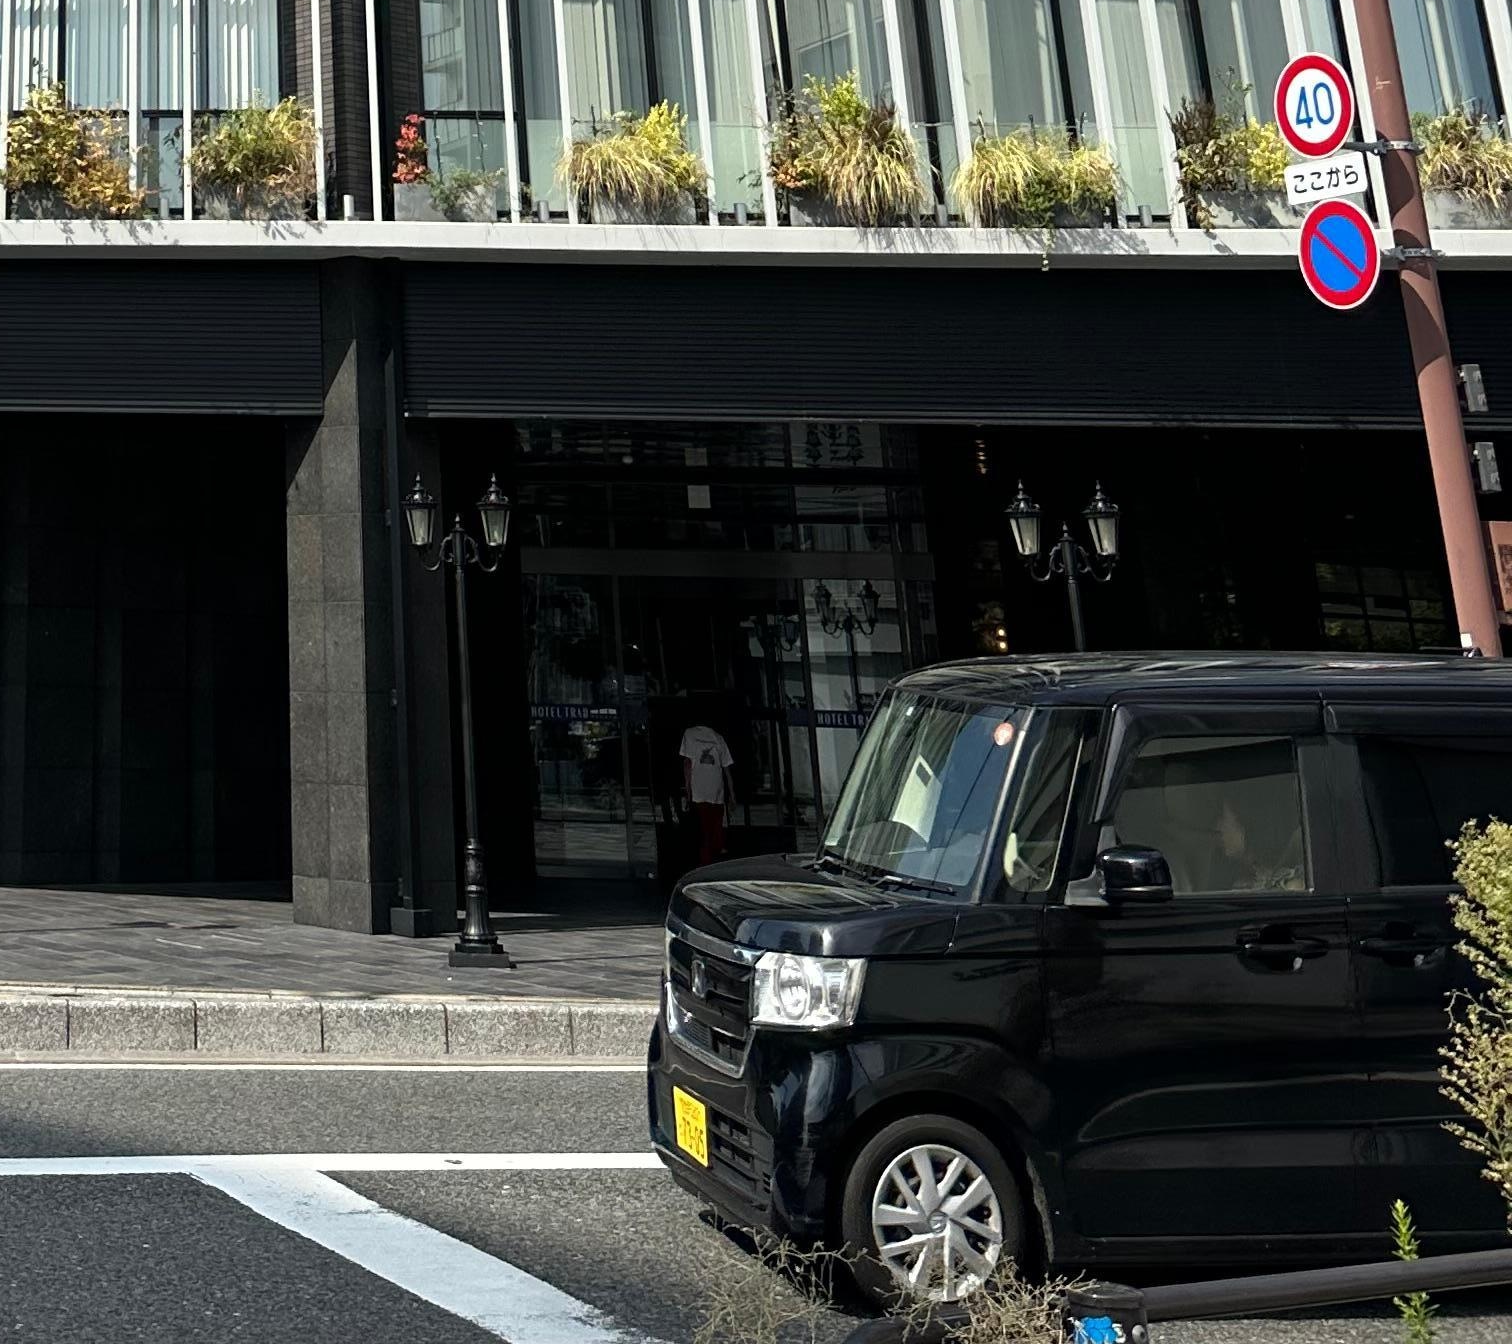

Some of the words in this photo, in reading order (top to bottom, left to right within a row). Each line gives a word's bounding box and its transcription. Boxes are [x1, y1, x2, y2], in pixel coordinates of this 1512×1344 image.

[1295, 82, 1335, 129] 40
[1293, 165, 1359, 194] ここから
[530, 705, 561, 718] HOTEL
[817, 712, 849, 727] HOTEL
